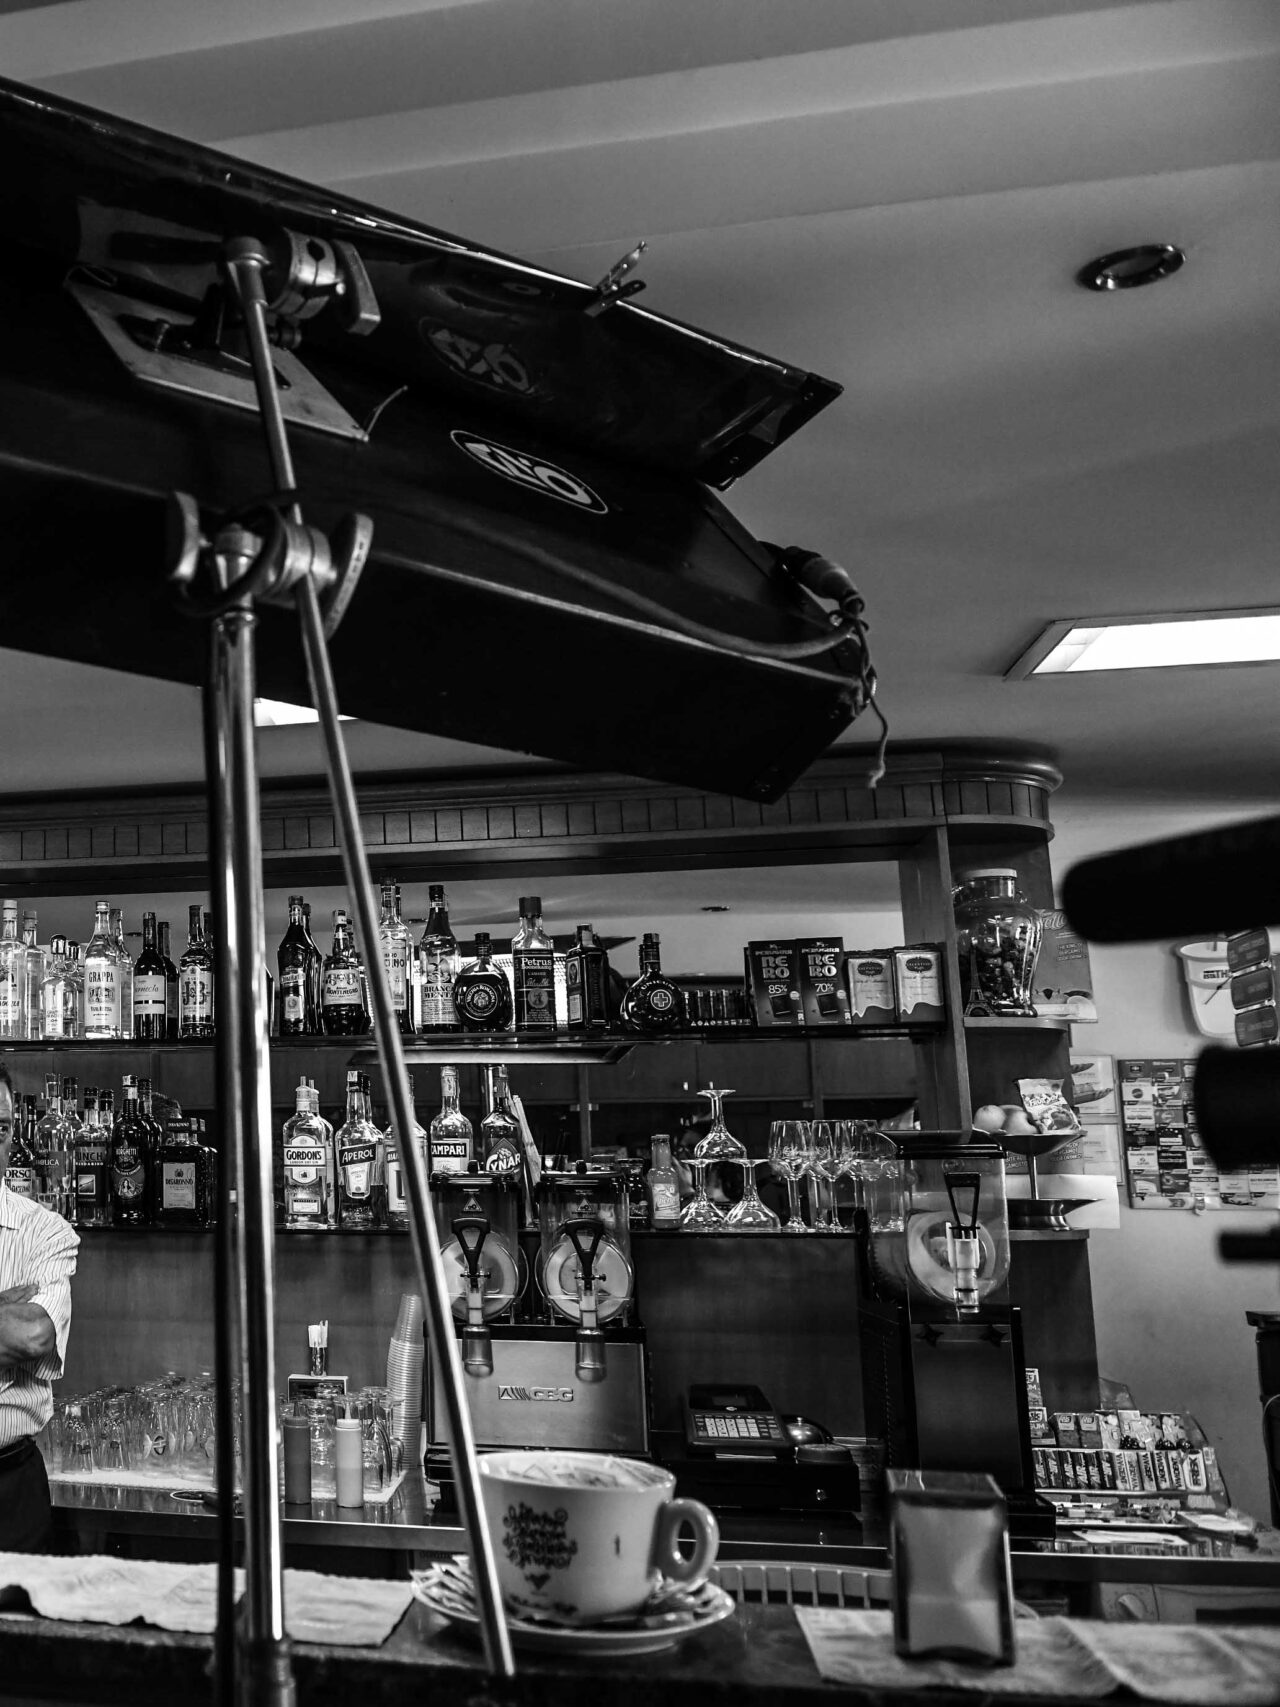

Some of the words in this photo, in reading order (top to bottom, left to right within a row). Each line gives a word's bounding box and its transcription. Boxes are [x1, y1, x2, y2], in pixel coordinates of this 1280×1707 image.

[521, 957, 553, 966] Petrus
[88, 971, 114, 983] GRAPPA
[768, 984, 788, 994] 85%
[814, 983, 835, 993] 70%
[286, 1149, 322, 1161] GORDON'S
[341, 1149, 374, 1164] APEROL
[485, 1154, 521, 1171] CYNAR
